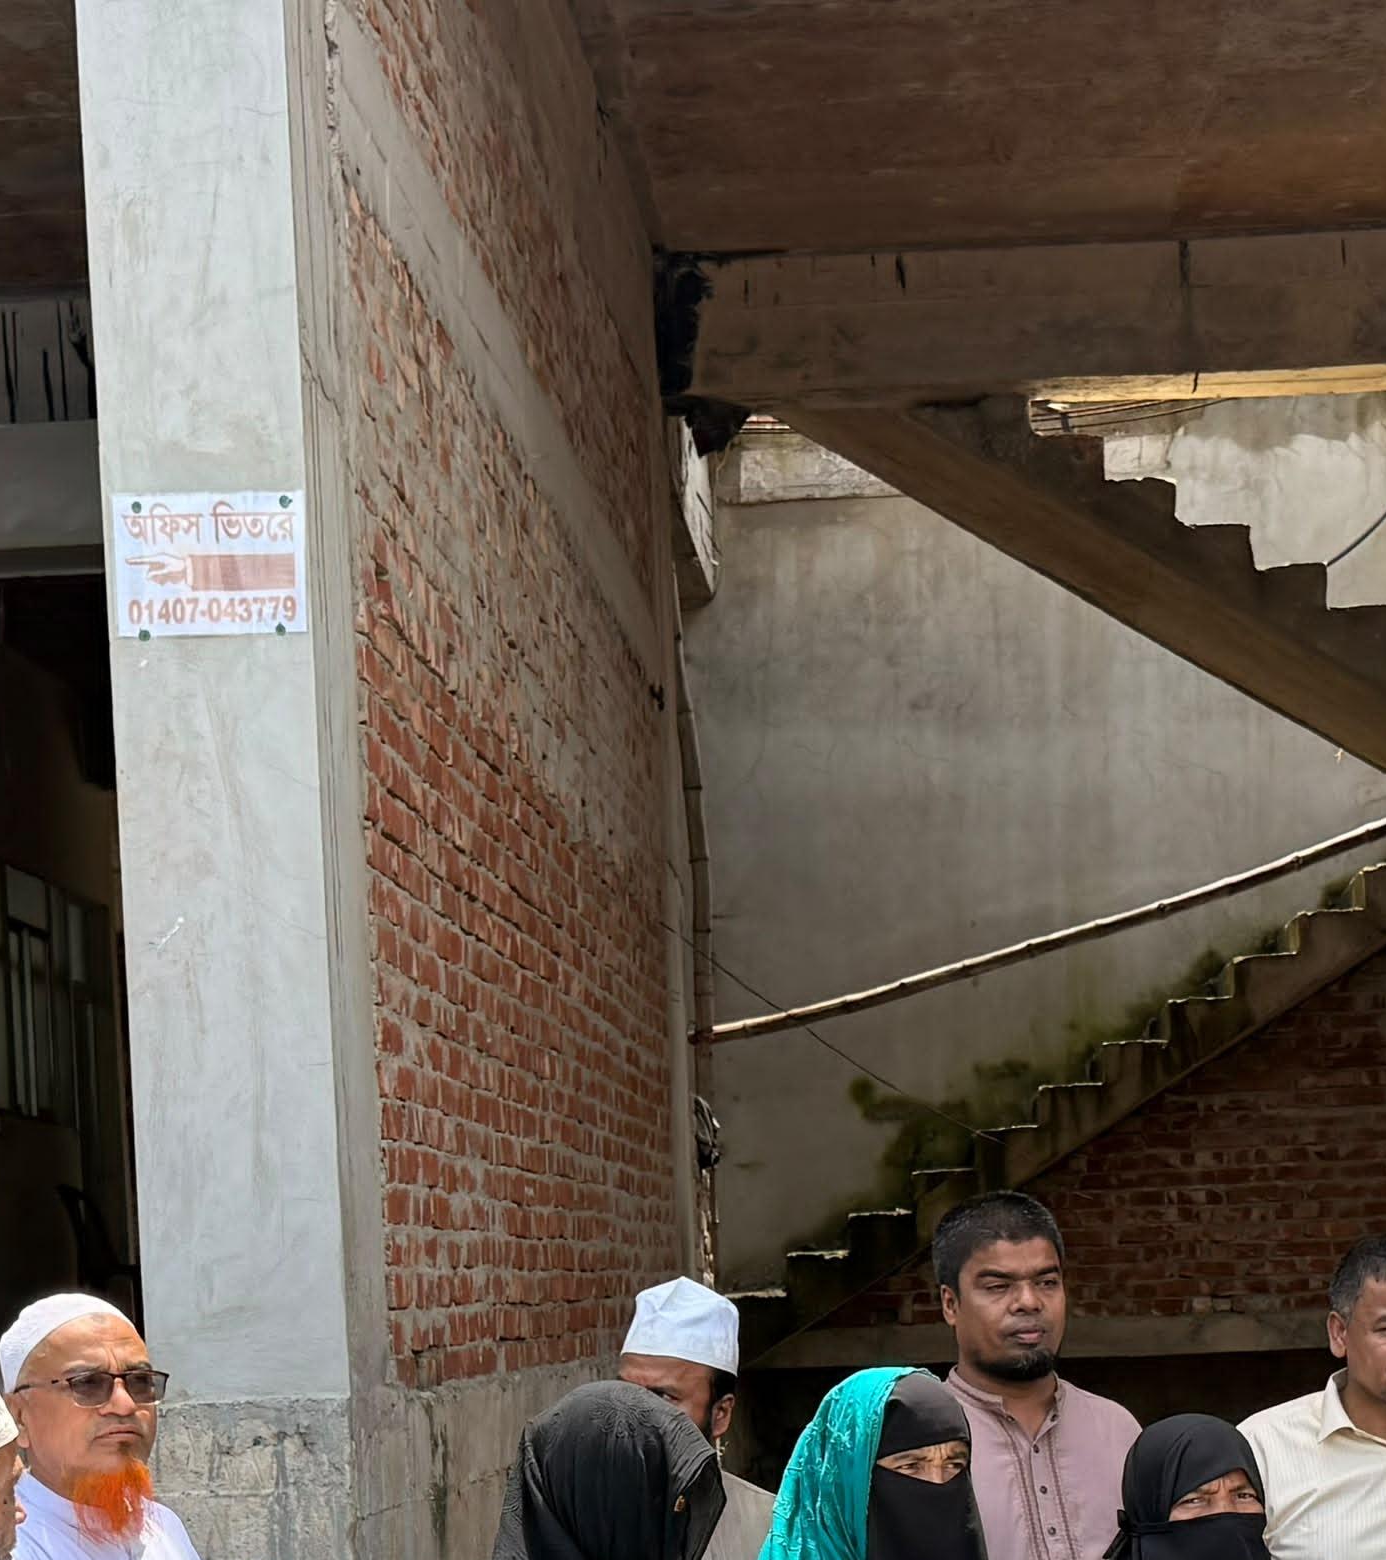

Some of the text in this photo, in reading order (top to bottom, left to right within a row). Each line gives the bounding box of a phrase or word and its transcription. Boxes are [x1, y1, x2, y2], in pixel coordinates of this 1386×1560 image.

[122, 500, 296, 544] অফিস ভিতরে
[128, 595, 297, 624] 01407-043779
